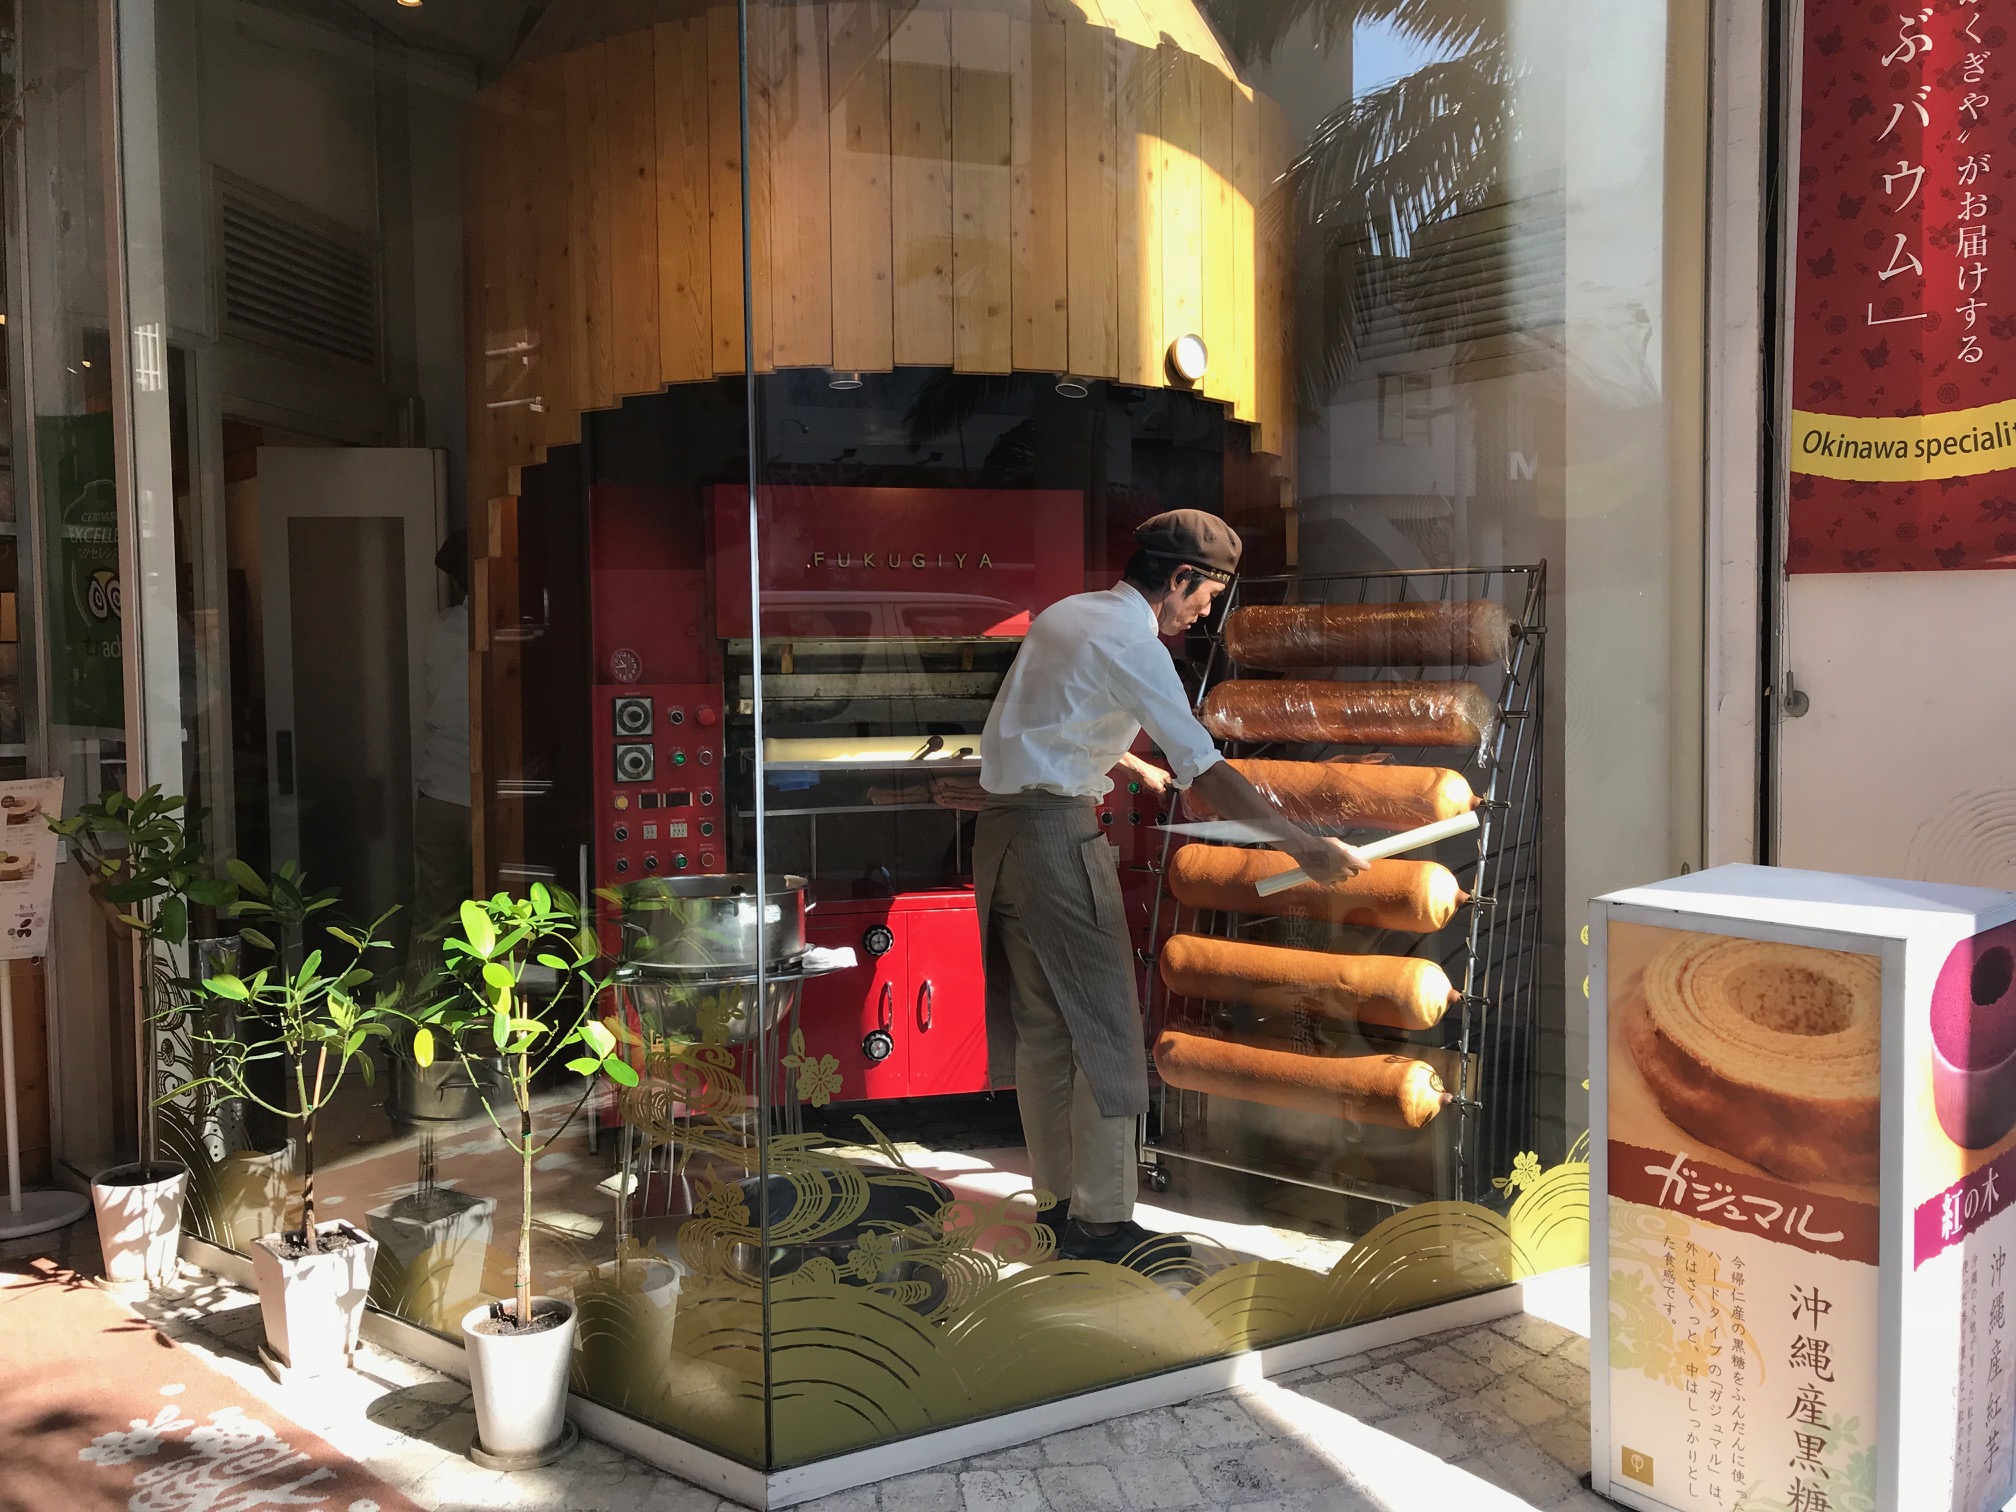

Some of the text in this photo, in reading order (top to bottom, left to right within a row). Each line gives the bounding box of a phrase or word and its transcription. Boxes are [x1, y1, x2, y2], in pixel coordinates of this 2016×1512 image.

[1802, 429, 1909, 459] Okinawa
[813, 552, 993, 569] FUKUGIYA
[1645, 1151, 1844, 1242] ガジュマル
[1941, 1168, 2000, 1240] 紅の木
[1663, 1235, 1677, 1325] た食感です。
[1785, 1284, 1834, 1512] 沖縄産黒糖
[1984, 1246, 2006, 1474] 沖縄産紅芋
